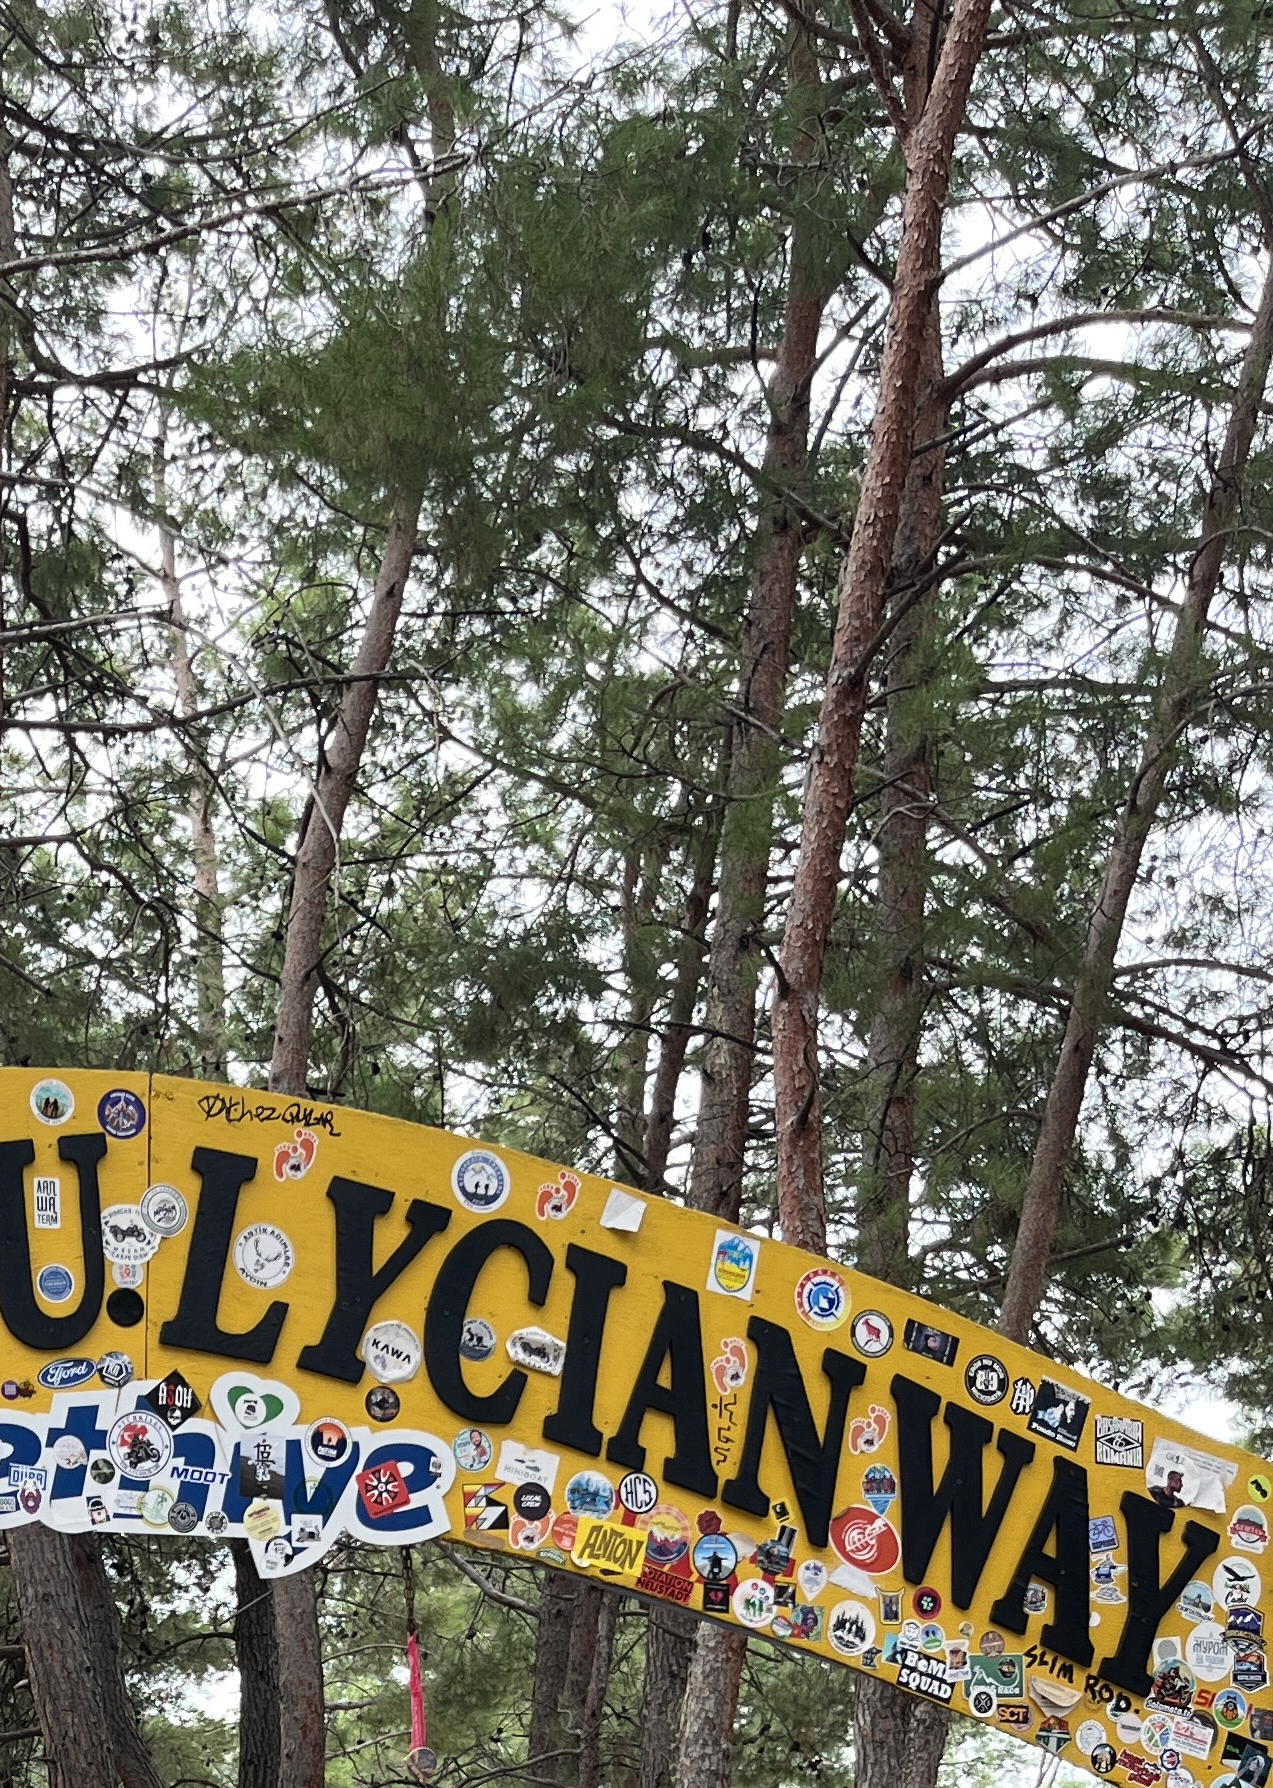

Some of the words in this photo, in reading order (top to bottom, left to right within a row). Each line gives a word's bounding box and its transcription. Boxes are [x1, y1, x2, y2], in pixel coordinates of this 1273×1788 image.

[242, 1225, 268, 1243] ANTİK
[269, 1228, 291, 1268] ADIMLAR
[239, 1267, 268, 1288] AYDIN
[371, 1338, 412, 1364] KAWA
[46, 1360, 89, 1386] Fjord
[158, 1145, 868, 1549] LYCIAN
[890, 1373, 1221, 1699] WAY
[170, 1466, 230, 1485] MOOT
[520, 1493, 542, 1502] LOCAL
[578, 1524, 646, 1571] ANTON
[1023, 1644, 1075, 1685] SLIM
[898, 1668, 953, 1700] SQUAD
